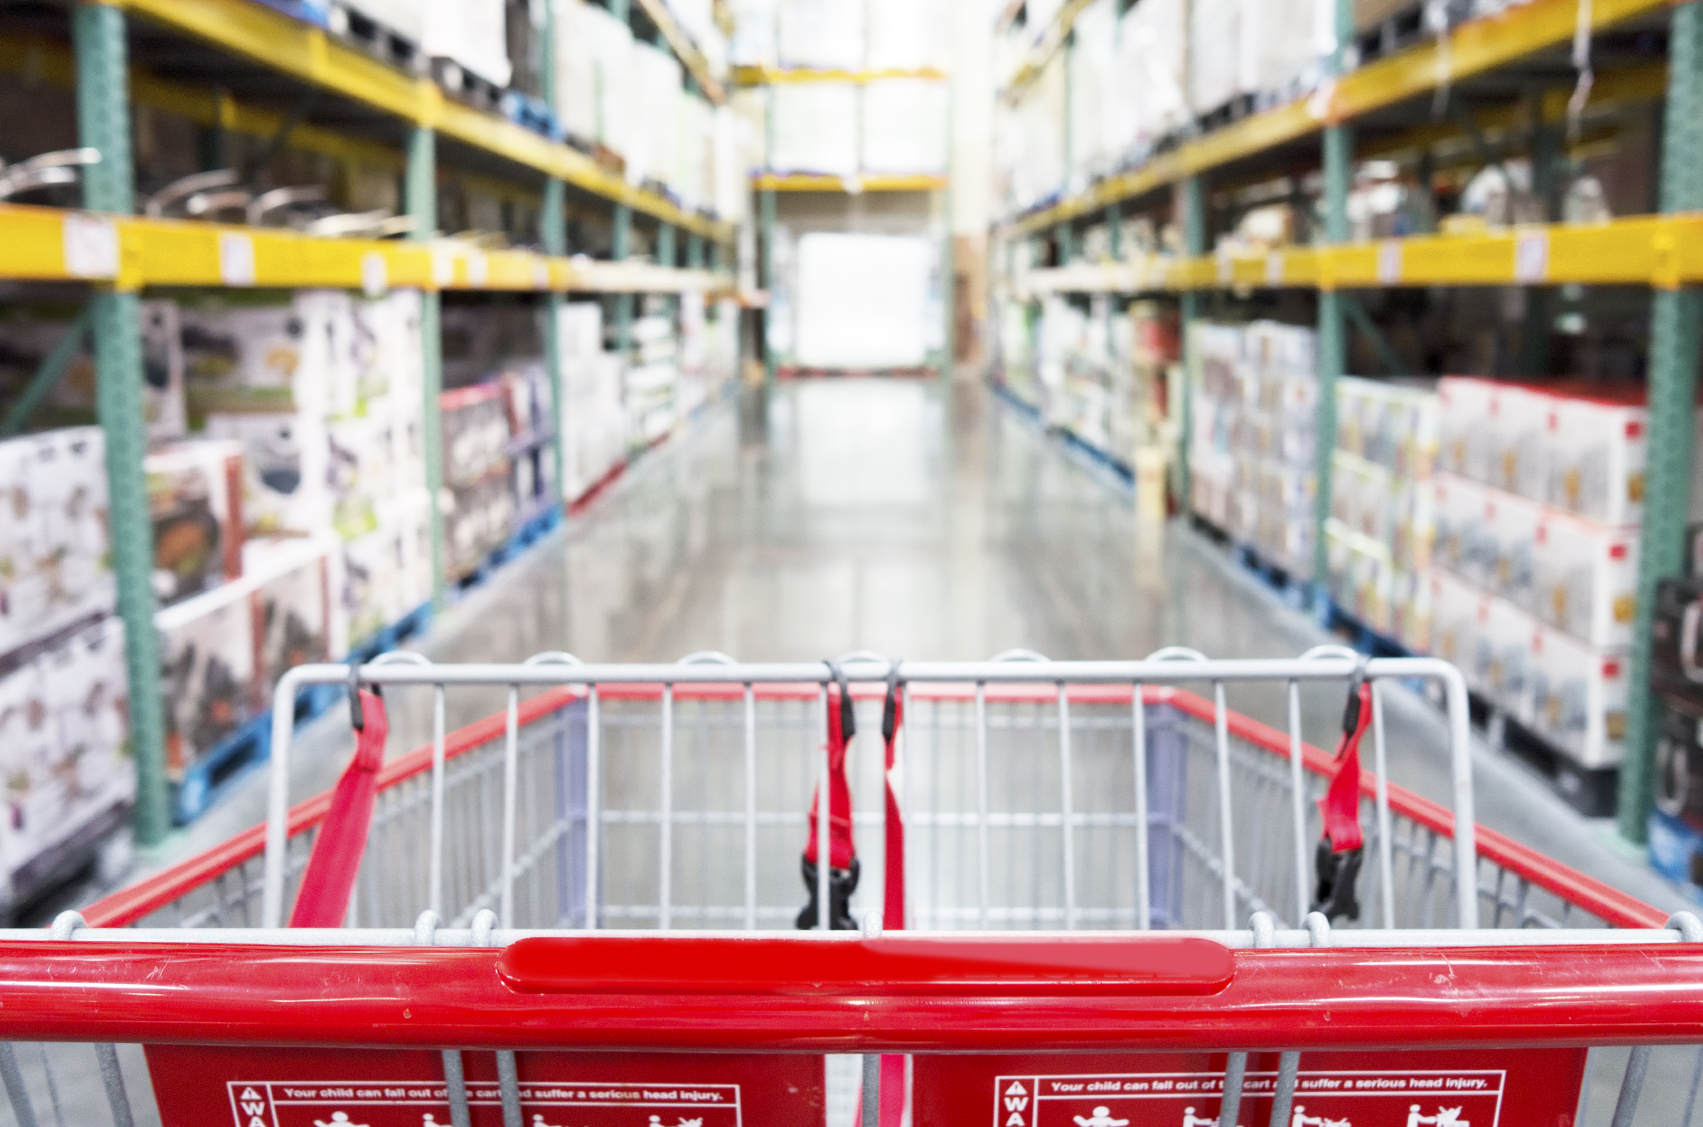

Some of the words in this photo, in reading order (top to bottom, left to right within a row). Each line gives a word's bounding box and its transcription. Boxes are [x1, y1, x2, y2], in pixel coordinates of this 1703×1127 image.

[1051, 1082, 1085, 1092] Your
[1087, 1081, 1121, 1092] child
[1123, 1082, 1149, 1091] can
[1152, 1080, 1173, 1091] fall
[1175, 1081, 1198, 1090] out
[1201, 1080, 1217, 1090] of
[1243, 1080, 1271, 1089] cart
[1302, 1079, 1342, 1089] suffer
[1344, 1080, 1354, 1089] a
[1355, 1079, 1407, 1088] serious
[1409, 1078, 1443, 1088] head
[1445, 1078, 1488, 1089] injury.
[284, 1088, 317, 1098] Your
[319, 1088, 354, 1098] child
[356, 1089, 382, 1098] can
[384, 1088, 406, 1098] fall
[408, 1089, 431, 1099] out
[534, 1089, 574, 1099] suffer
[577, 1090, 587, 1099] a
[589, 1090, 641, 1100] serious
[643, 1090, 678, 1100] head
[680, 1091, 724, 1102] injury.
